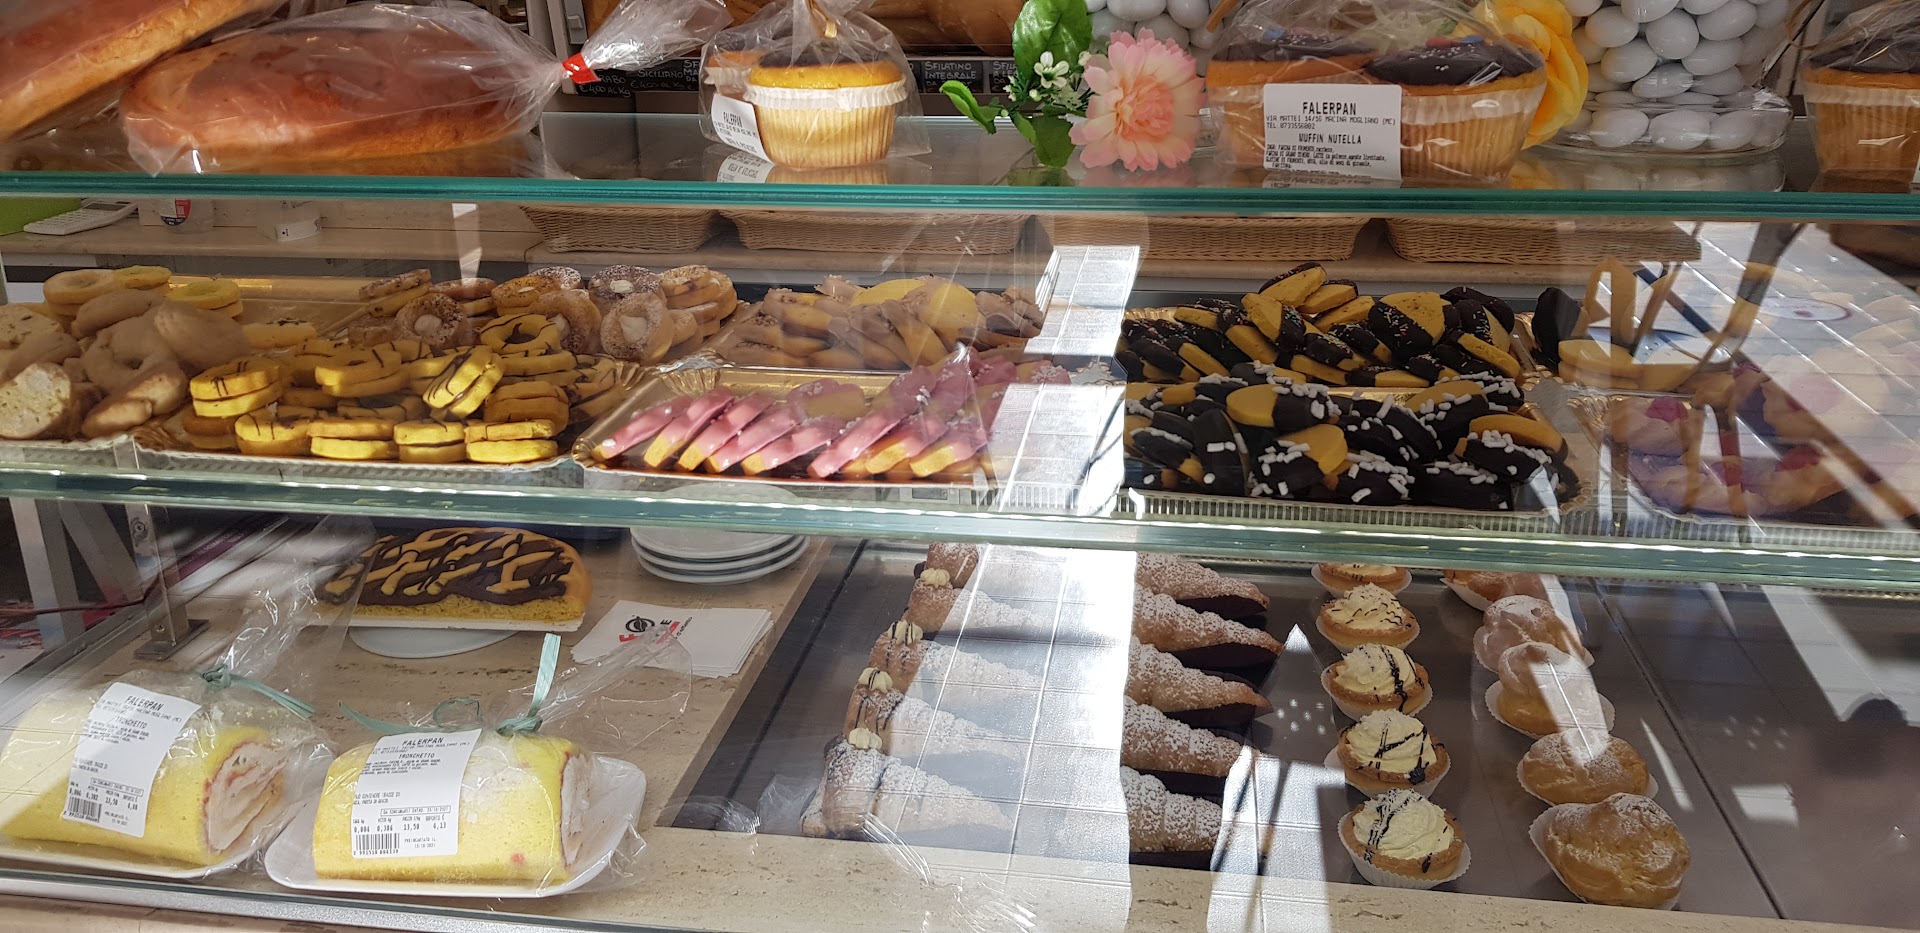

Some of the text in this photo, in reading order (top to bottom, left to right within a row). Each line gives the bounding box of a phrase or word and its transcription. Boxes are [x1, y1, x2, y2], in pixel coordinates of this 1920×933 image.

[683, 60, 700, 68] SF
[924, 61, 972, 71] SFILATINO
[637, 70, 684, 79] SICILIANO
[683, 68, 699, 76] MA
[924, 70, 976, 80] INTEGRALE
[598, 74, 626, 84] RABO
[618, 88, 632, 98] Kg
[1302, 102, 1356, 116] FALERPAN
[1298, 132, 1362, 144] MUFFIN NUTELLA
[125, 696, 164, 712] FALERPAN
[402, 737, 444, 746] FALERPAN
